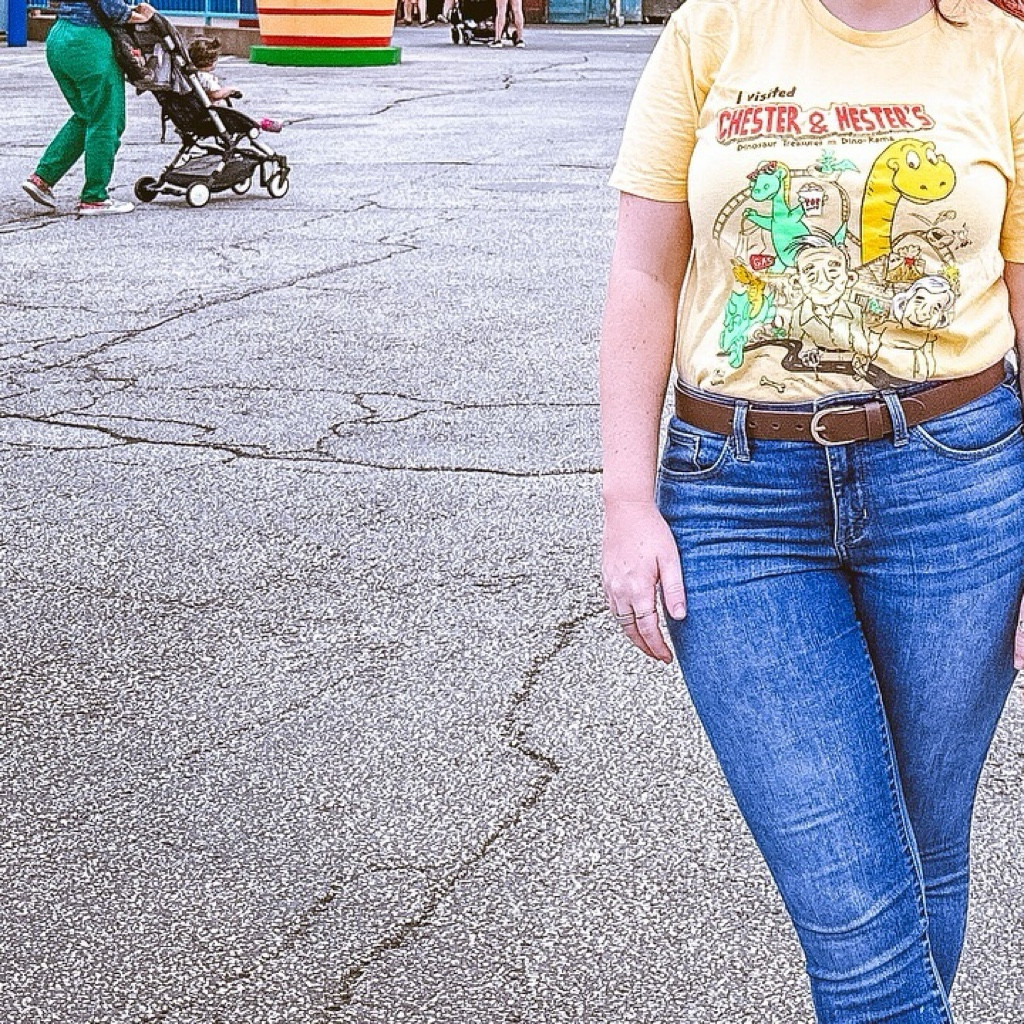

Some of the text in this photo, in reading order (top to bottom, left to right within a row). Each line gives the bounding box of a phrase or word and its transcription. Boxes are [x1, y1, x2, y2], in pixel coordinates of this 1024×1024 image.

[736, 86, 797, 104] I visited
[718, 105, 932, 139] CHESTER & HESTER'S
[737, 140, 777, 152] Dinosaur
[753, 256, 774, 267] GAS
